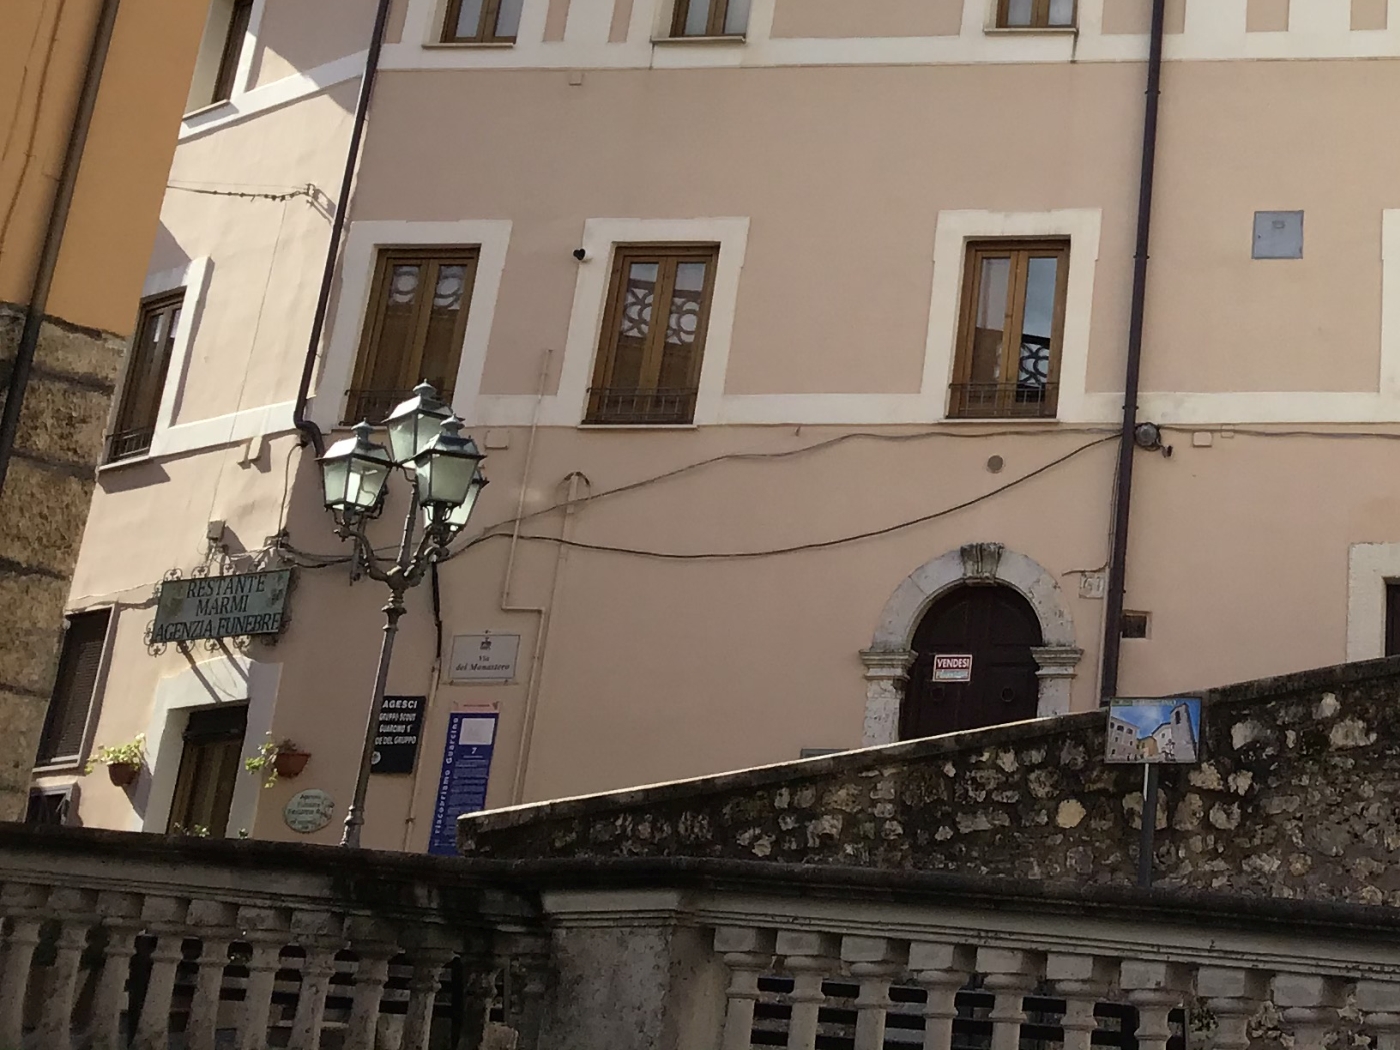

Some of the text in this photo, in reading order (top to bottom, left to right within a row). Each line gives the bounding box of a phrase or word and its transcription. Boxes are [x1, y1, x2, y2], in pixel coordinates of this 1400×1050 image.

[187, 574, 267, 598] RESTANTE
[197, 595, 249, 616] MARMI
[155, 613, 281, 640] AGENZIA FUNEBRE
[470, 663, 510, 671] Monastero
[938, 659, 969, 668] VENDESI
[382, 700, 418, 709] AGESCI
[378, 712, 416, 722] GRUPPO SCOUT
[379, 724, 406, 733] GUARCINO
[382, 736, 394, 745] DEL
[394, 736, 417, 744] GRUPPO
[446, 717, 458, 764] Guarcino
[471, 746, 478, 754] 7
